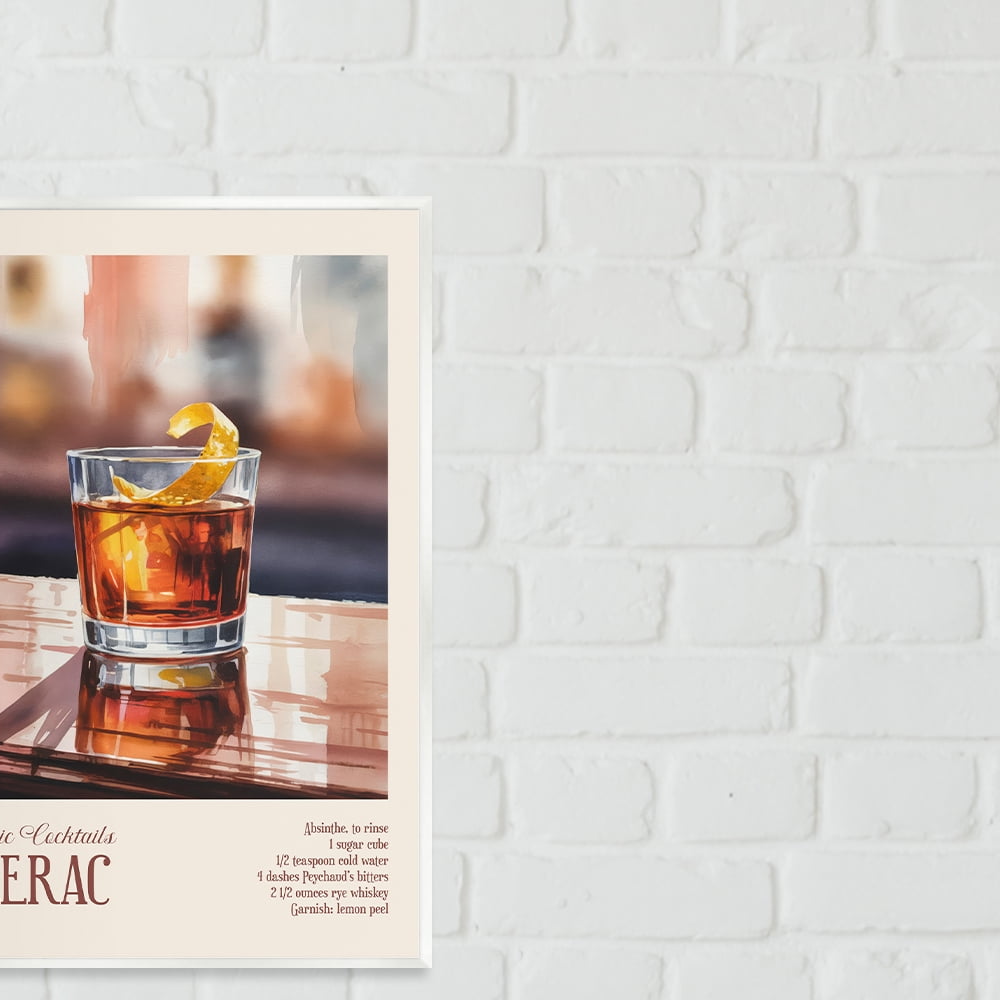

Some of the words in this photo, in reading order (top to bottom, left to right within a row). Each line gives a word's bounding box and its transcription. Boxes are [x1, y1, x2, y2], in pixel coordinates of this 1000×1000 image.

[19, 822, 117, 846] Cocktails
[352, 823, 361, 835] to
[364, 822, 389, 834] rinse
[329, 838, 333, 850] 1
[336, 840, 364, 853] sugar
[367, 837, 389, 850] cube
[276, 854, 290, 868] 1/2
[292, 855, 336, 868] teaspoon
[338, 854, 359, 866] cold
[361, 856, 389, 867] water
[257, 870, 263, 882] 4
[266, 870, 300, 883] dashes
[302, 869, 355, 884] Peychaud's
[357, 870, 389, 883] bitters
[270, 886, 277, 898] 2
[279, 886, 293, 901] 1/2
[295, 888, 329, 899] ounces
[331, 889, 348, 901] rye
[350, 886, 389, 901] whiskey
[290, 902, 334, 917] Garnish:
[336, 902, 367, 915] lemon
[369, 902, 389, 917] peel
